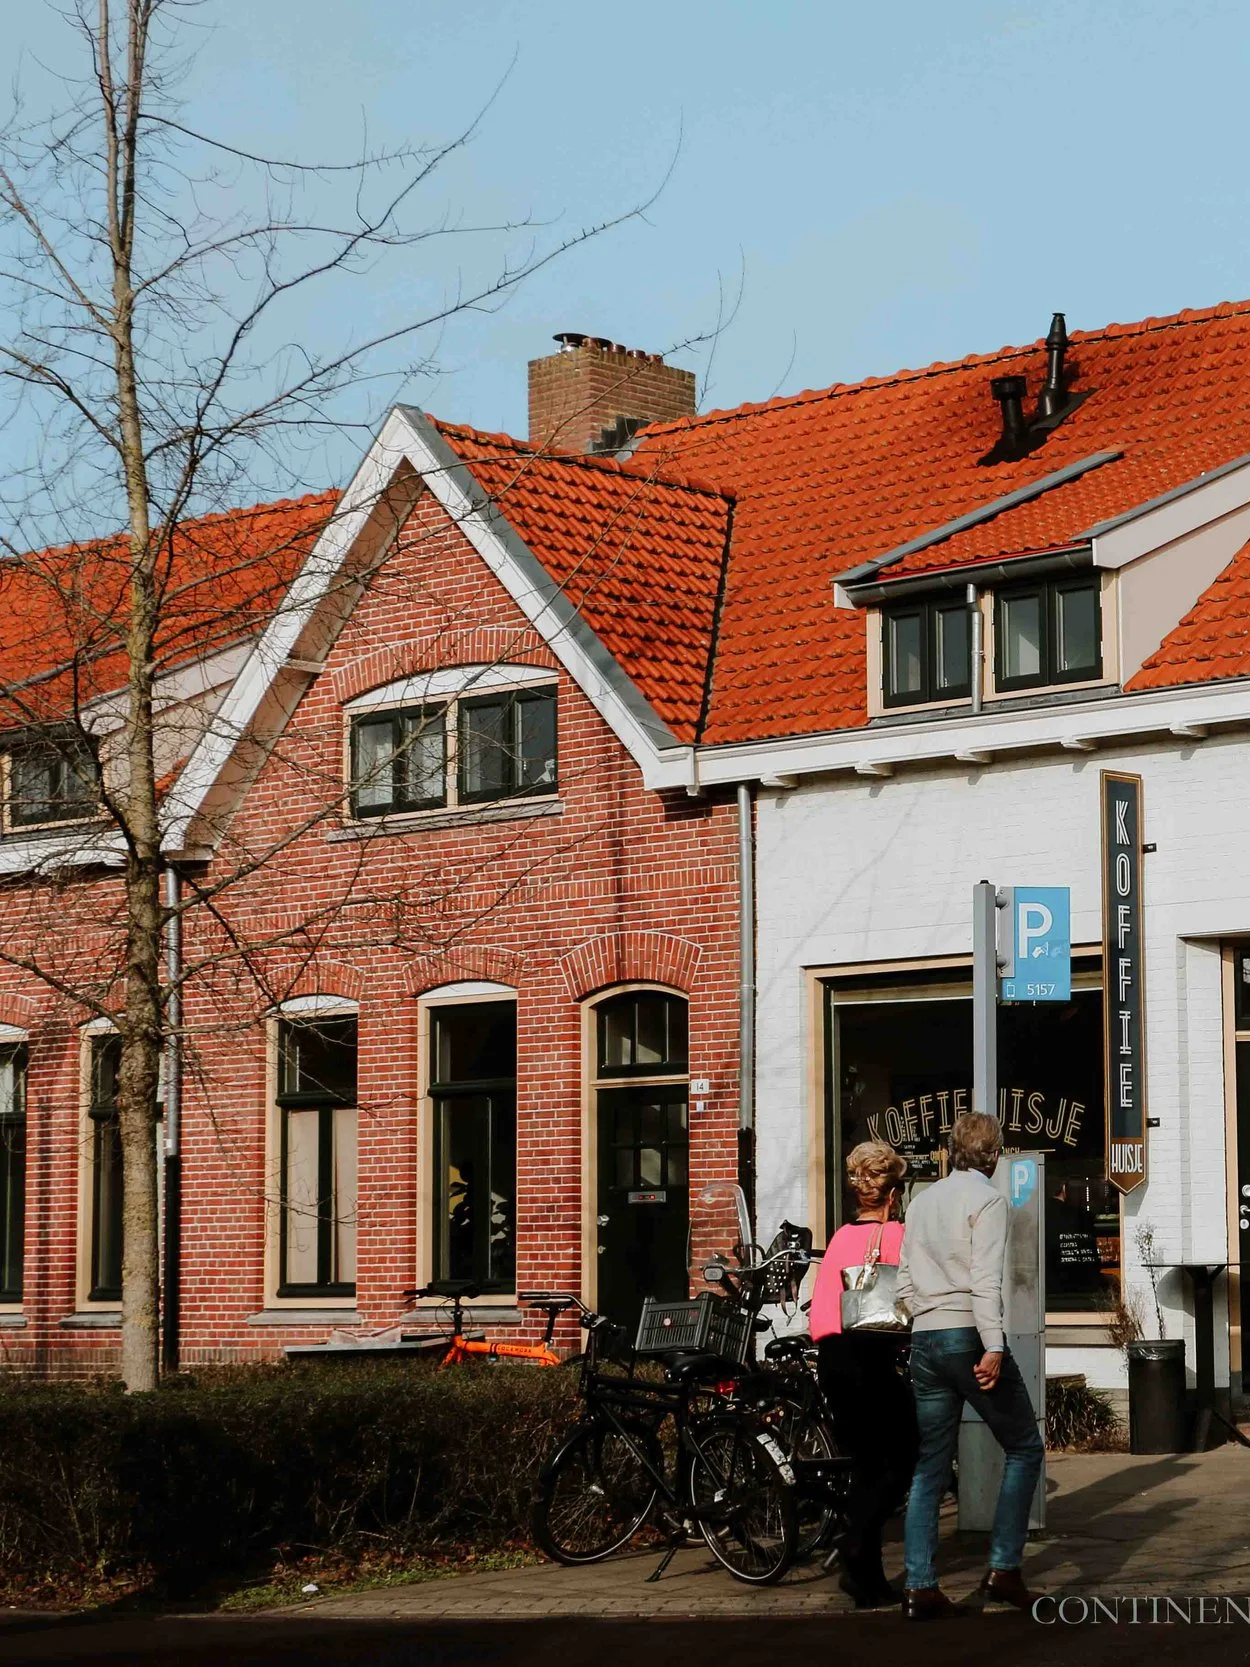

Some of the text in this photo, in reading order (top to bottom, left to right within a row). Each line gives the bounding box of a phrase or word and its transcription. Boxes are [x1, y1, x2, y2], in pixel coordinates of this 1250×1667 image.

[1018, 902, 1053, 958] P
[1115, 799, 1133, 1108] KOFFIE
[1026, 983, 1057, 996] 5157
[866, 1088, 1086, 1147] KOFFIEISJE
[1111, 1143, 1143, 1173] HUISJE
[1014, 1165, 1029, 1199] P
